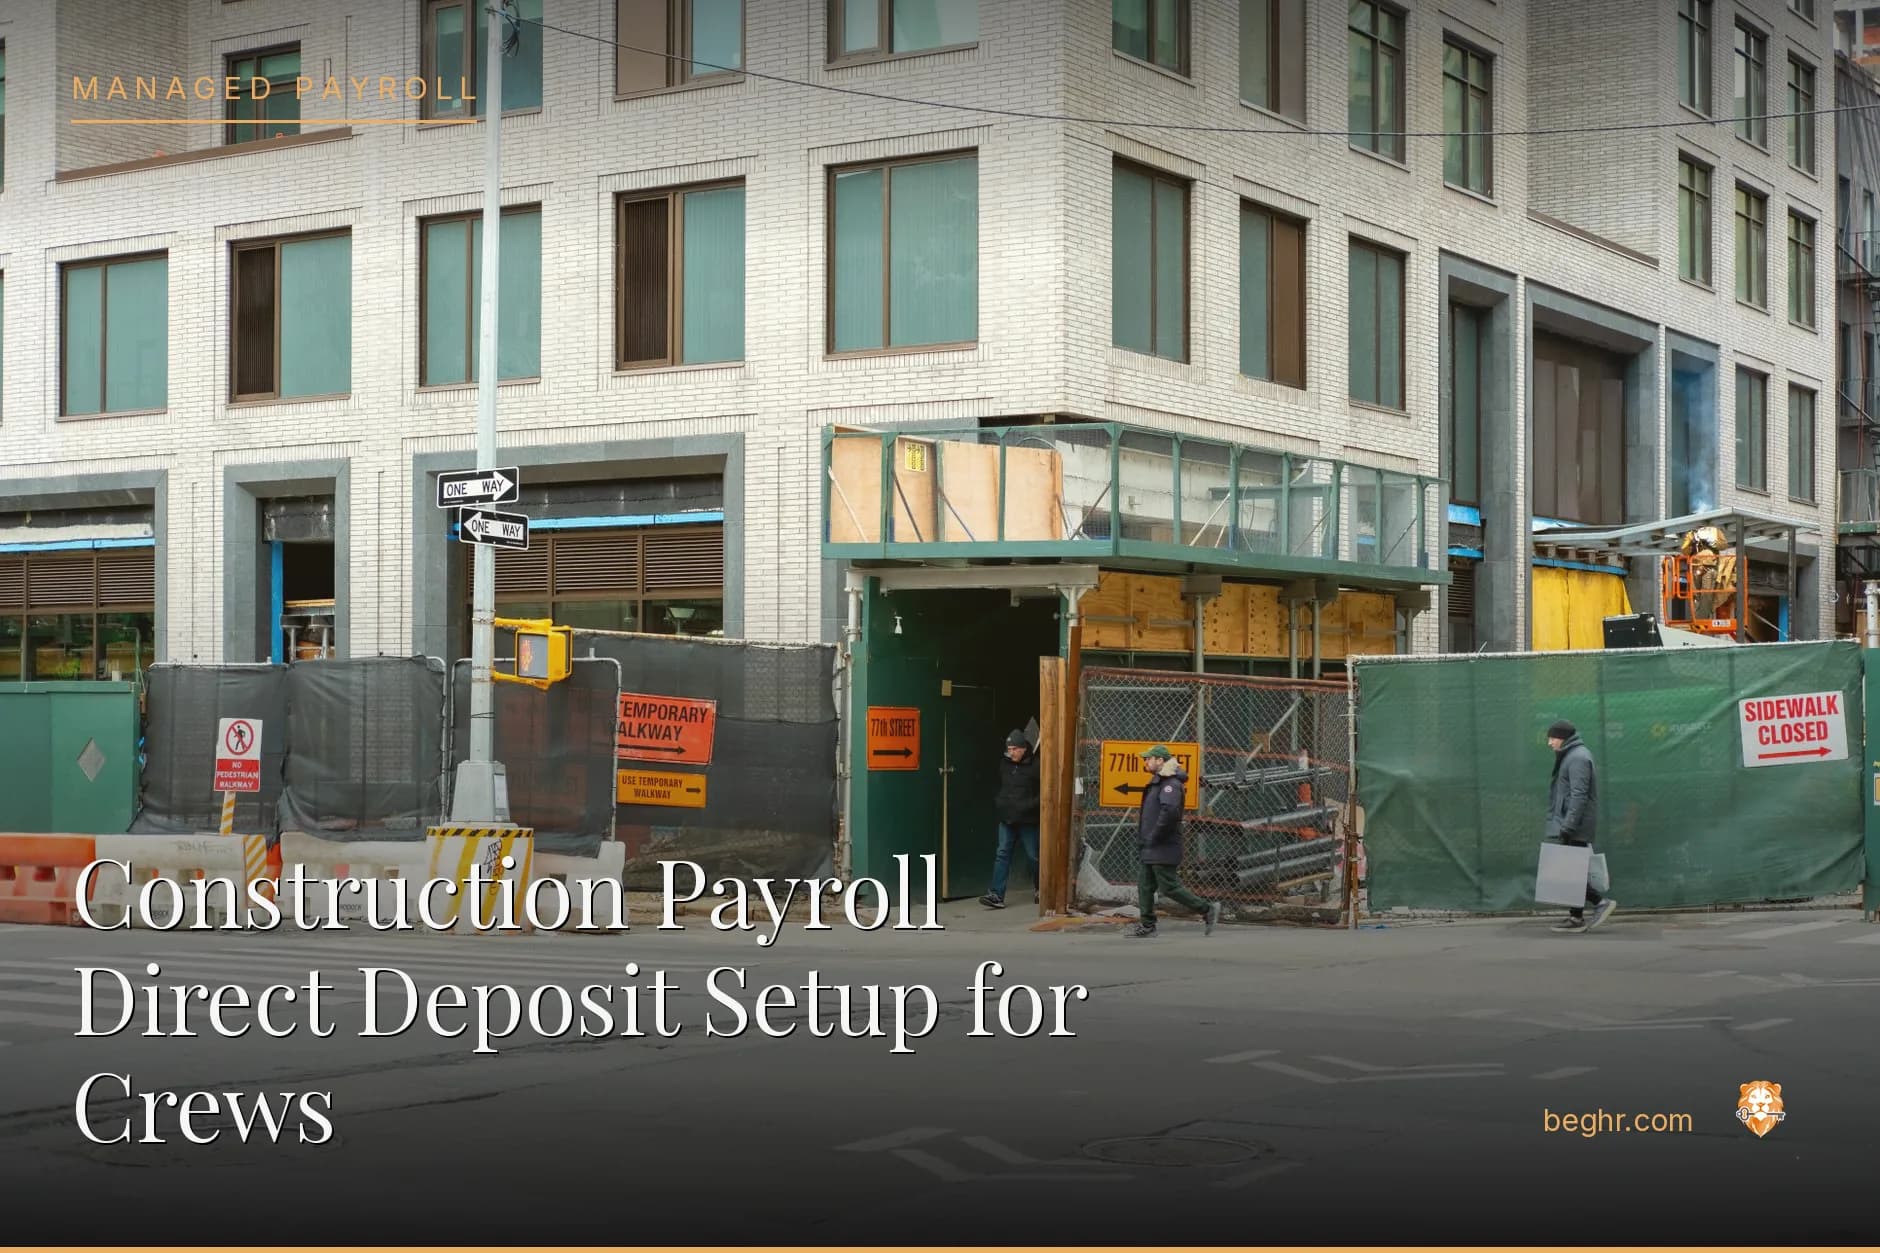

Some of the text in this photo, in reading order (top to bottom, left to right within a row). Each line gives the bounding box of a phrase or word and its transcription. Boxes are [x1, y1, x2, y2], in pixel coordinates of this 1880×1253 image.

[446, 479, 504, 497] ONE WAY
[471, 520, 521, 538] ONE WAY
[1744, 694, 1839, 722] SIDEWALK
[618, 721, 683, 741] ALKWAY
[889, 718, 916, 737] STREET
[1758, 720, 1829, 746] CLOSED
[1109, 753, 1139, 772] 77th
[216, 771, 258, 779] PEDESTRIAN
[621, 775, 683, 788] USE TEMPORARY
[634, 788, 671, 799] WALKWAY
